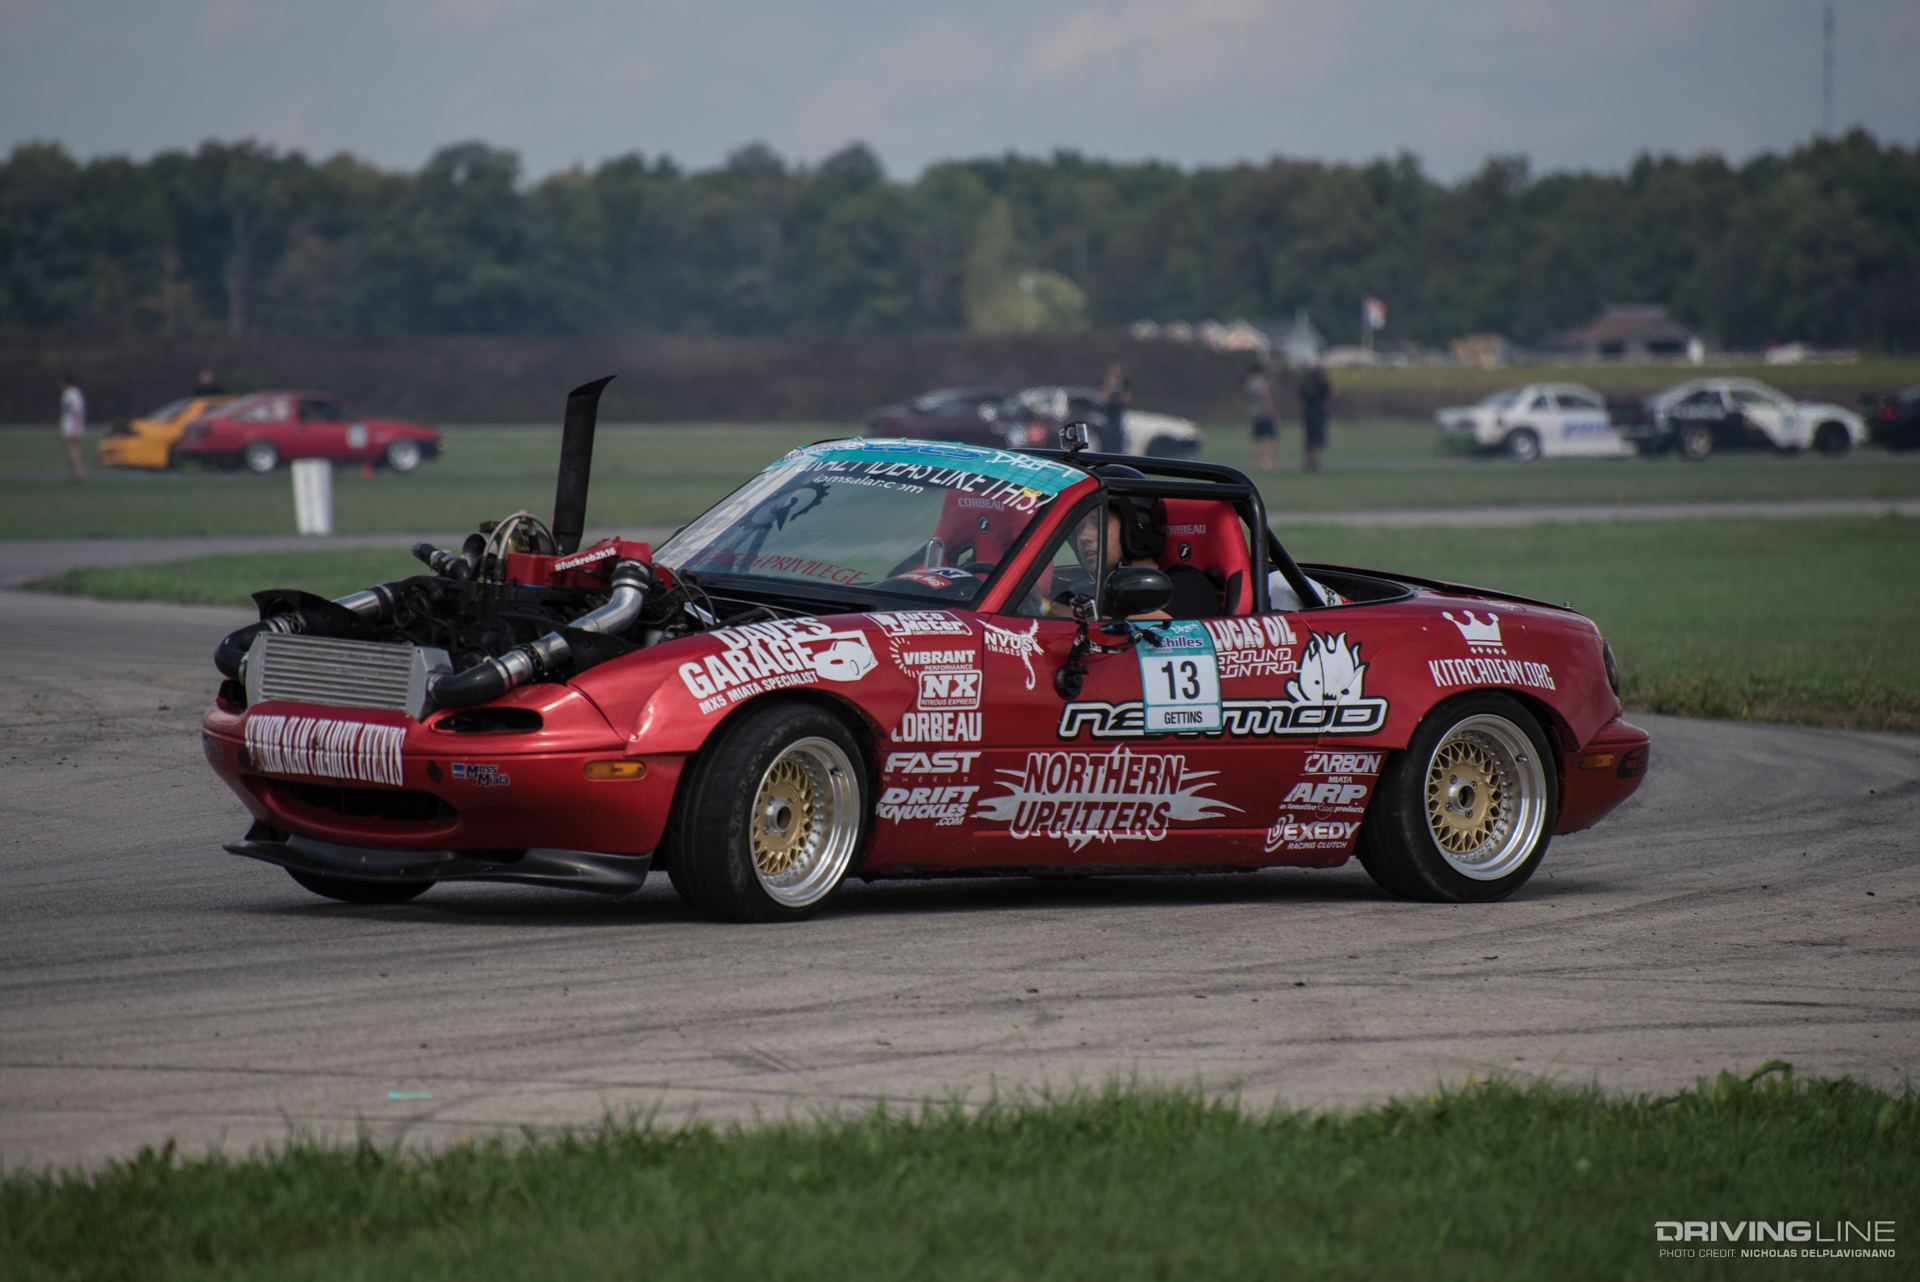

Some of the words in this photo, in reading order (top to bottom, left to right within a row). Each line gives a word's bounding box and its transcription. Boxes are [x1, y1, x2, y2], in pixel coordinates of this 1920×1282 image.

[928, 468, 986, 492] LIKE
[958, 497, 1005, 511] CORBEAU
[1163, 524, 1206, 535] ORBEAU
[555, 547, 616, 571] #fuckrob2k16
[760, 555, 868, 586] PRIVILEGE
[709, 617, 832, 650] DAVE'S
[984, 631, 1033, 652] NVUS
[1203, 617, 1265, 651] LUCAS
[1262, 616, 1297, 646] OIL
[903, 649, 975, 665] VIBRANT
[987, 644, 1021, 657] IMAGES
[1216, 647, 1291, 665] GROUND
[678, 639, 816, 699] GARAGE
[1218, 660, 1302, 678] CONTROL
[1427, 658, 1556, 690] KITACADEMY.ORG
[923, 674, 978, 698] NX
[1161, 660, 1200, 700] 13
[698, 694, 727, 715] MX5
[726, 682, 764, 703] MIATA
[761, 671, 819, 691] SPECIALIST
[921, 698, 947, 706] NITROUS
[1164, 711, 1203, 724] GETTINS
[885, 752, 982, 773] FAST
[1022, 751, 1186, 795] NORTHERN
[1304, 754, 1382, 773] CARBON
[880, 785, 980, 805] DRIFT
[1283, 782, 1368, 805] ARP
[875, 803, 969, 826] KNUCKLES
[1334, 805, 1365, 813] products
[1010, 800, 1172, 841] UPFITTERS
[1283, 821, 1362, 841] EXEDY
[1287, 842, 1317, 850] RACING
[1317, 841, 1347, 849] CLUTCH
